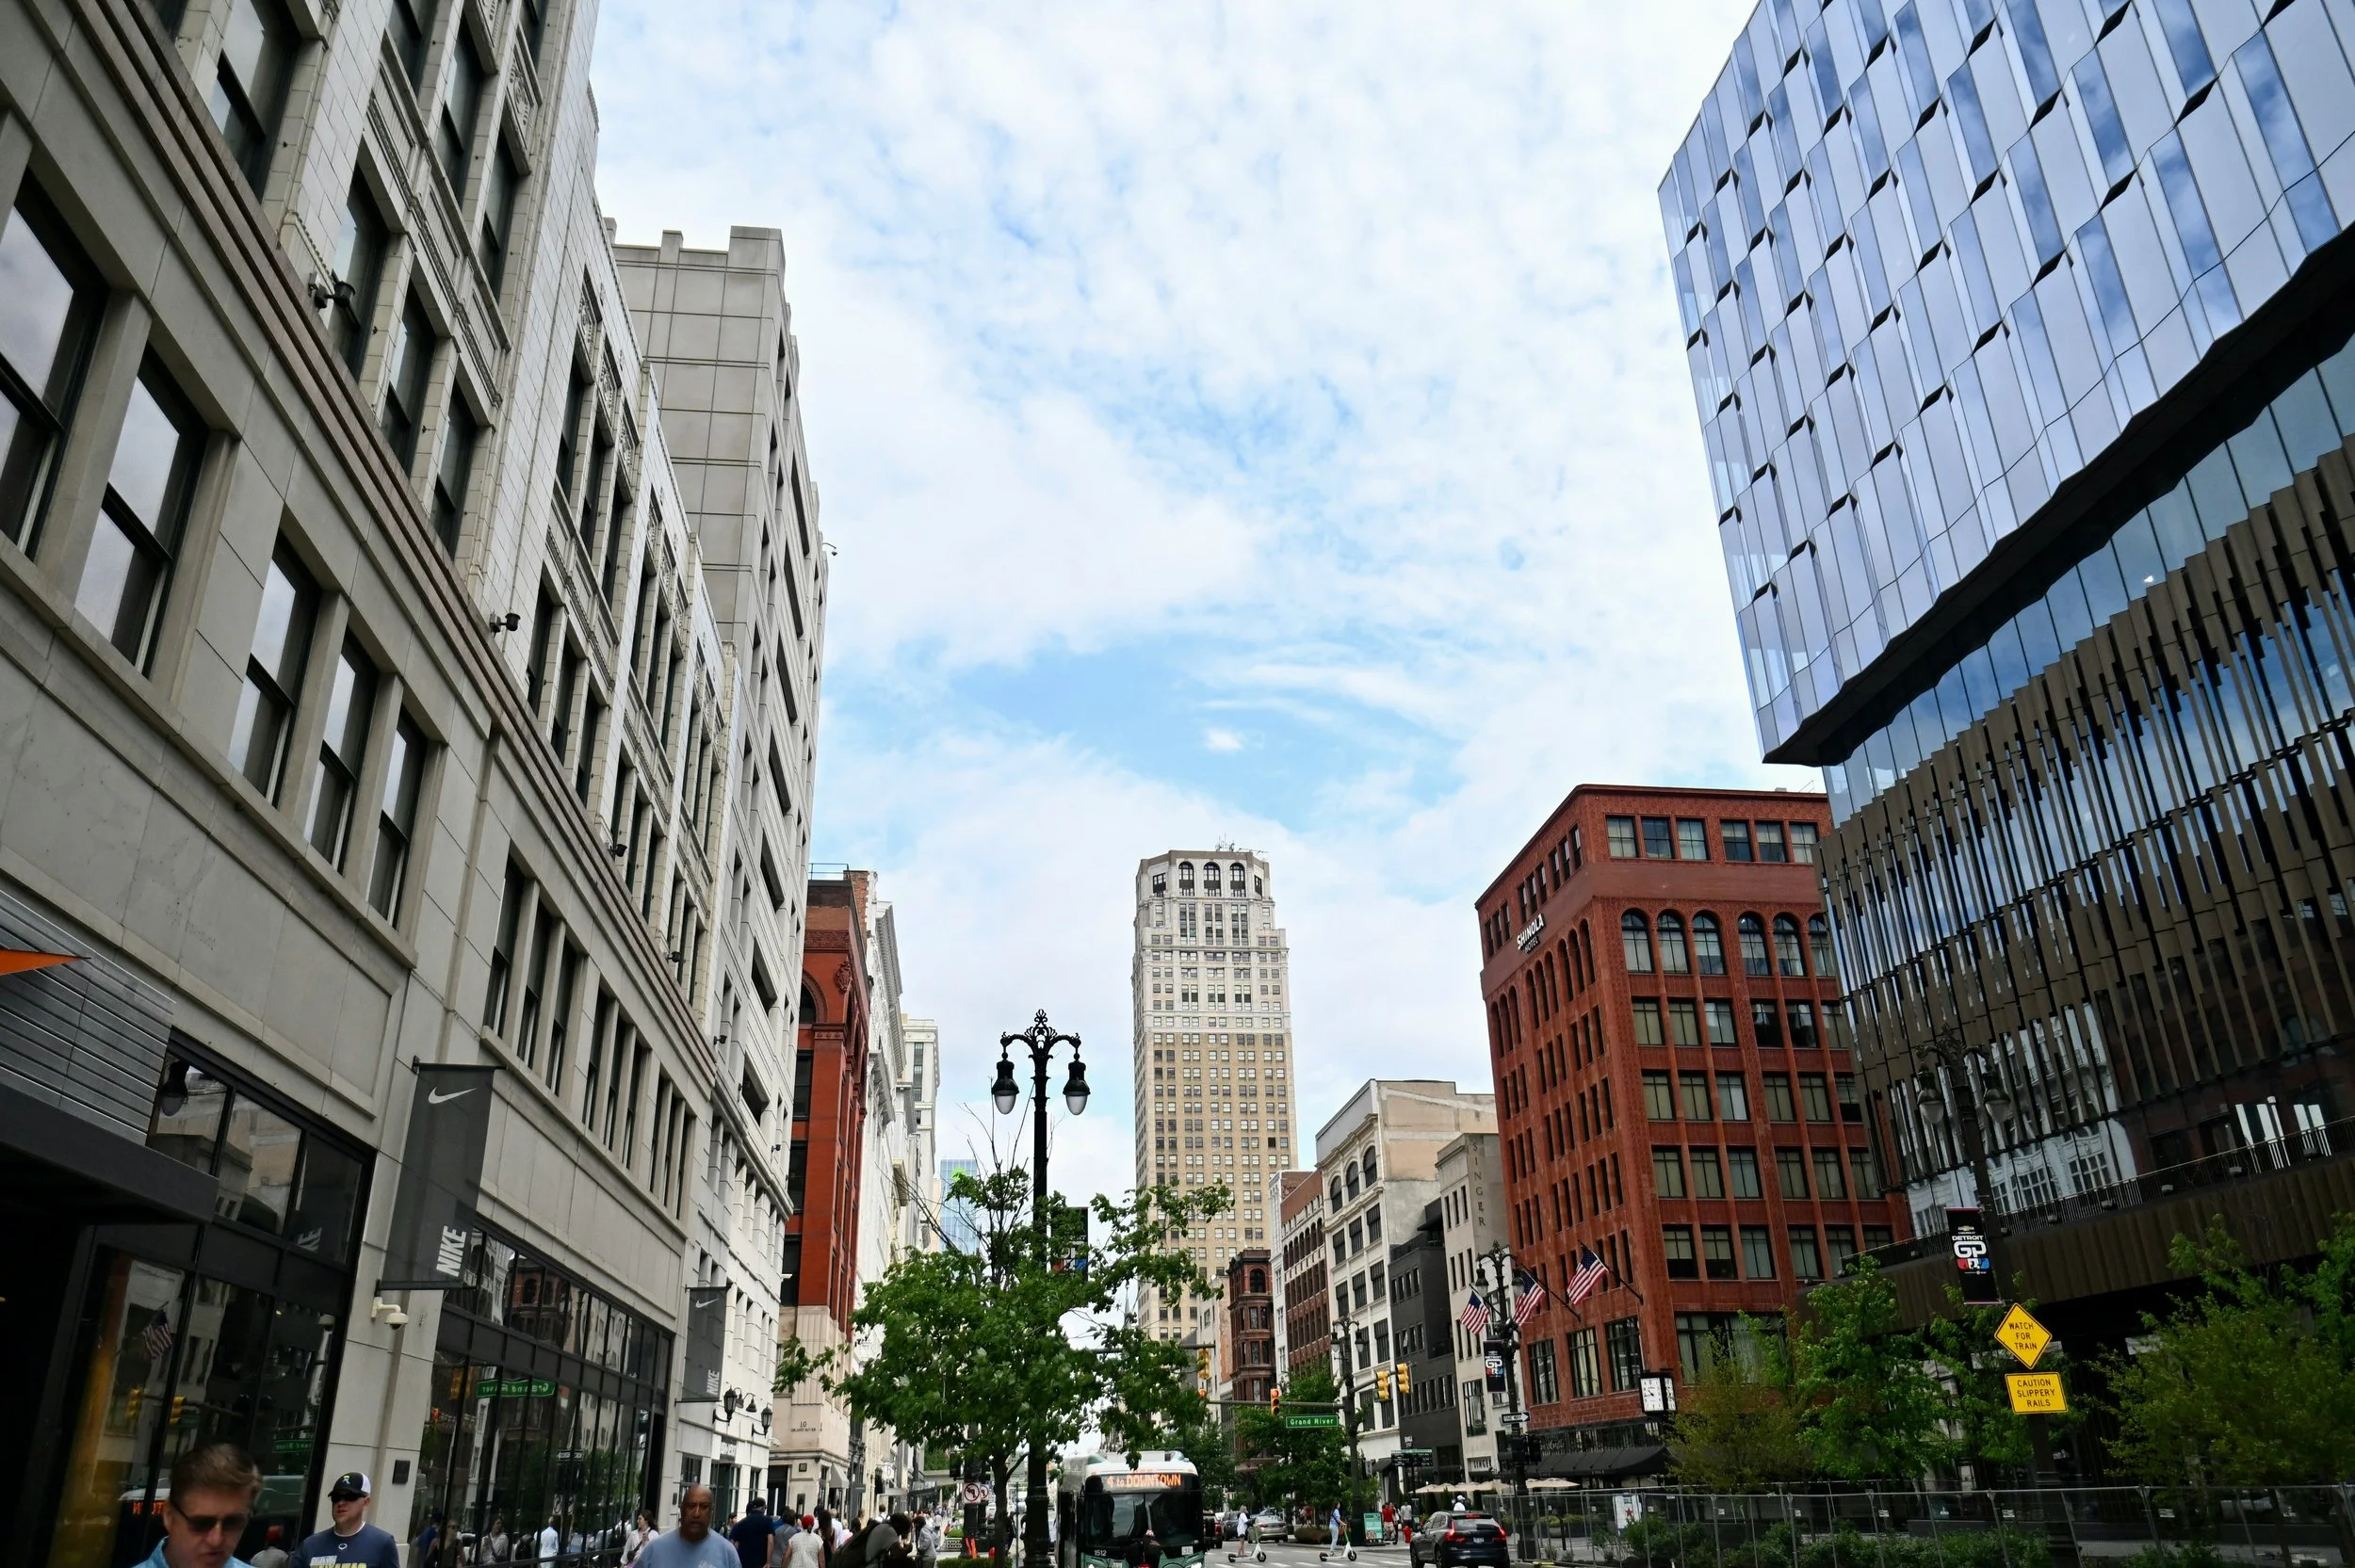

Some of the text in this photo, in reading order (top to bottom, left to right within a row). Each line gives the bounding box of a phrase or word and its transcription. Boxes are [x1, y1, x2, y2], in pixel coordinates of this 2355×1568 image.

[1517, 913, 1544, 950] SHINOLA
[1524, 936, 1538, 953] HOTEL
[1472, 1142, 1486, 1226] SINGER
[436, 1225, 467, 1277] NIKE
[1954, 1240, 1987, 1258] GP
[2016, 1332, 2031, 1340] FOR
[2015, 1342, 2038, 1350] TRAIN
[1486, 1359, 1502, 1369] GP
[706, 1369, 720, 1396] NIKE
[2017, 1389, 2055, 1398] SLIPPERY
[1107, 1474, 1181, 1488] 4 to DOWNTOWN
